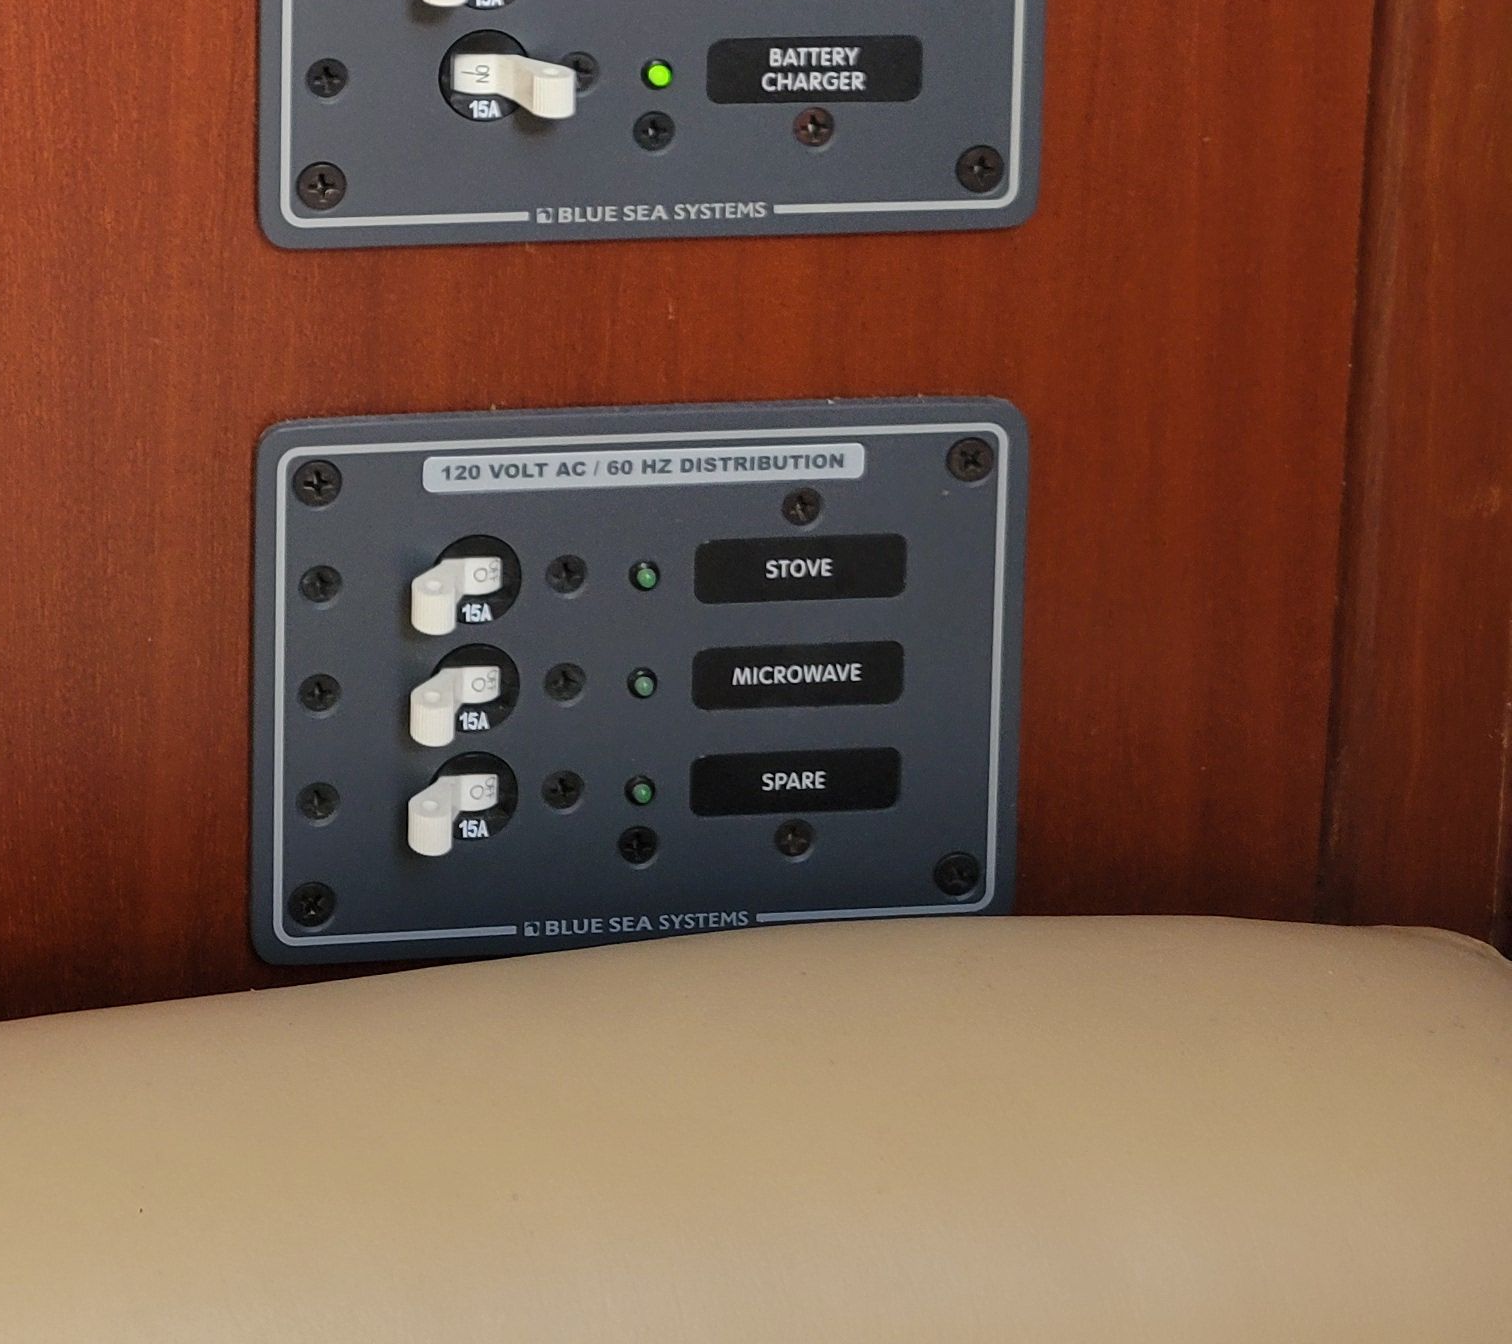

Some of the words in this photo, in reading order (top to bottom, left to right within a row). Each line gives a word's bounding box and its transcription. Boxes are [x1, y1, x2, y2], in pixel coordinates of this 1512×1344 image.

[770, 47, 858, 66] BATTERY
[476, 65, 489, 84] ON
[762, 72, 865, 91] CHARGER
[470, 100, 500, 118] 15A
[558, 206, 617, 223] BLUE
[624, 205, 668, 221] SEA
[674, 202, 767, 219] SYSTEMS
[442, 465, 480, 480] 120
[489, 463, 548, 479] VOLT
[556, 462, 585, 476] AC
[607, 460, 633, 475] 60
[642, 459, 672, 474] HZ
[680, 454, 844, 473] DISTRIBUTION
[766, 559, 832, 578] STOVE
[462, 604, 491, 622] 15A
[733, 664, 861, 685] MICROWAVE
[460, 712, 489, 730] 15A
[762, 771, 825, 790] SPARE
[459, 820, 488, 837] 15A
[546, 919, 603, 935] BLUE
[609, 916, 652, 932] SEA
[660, 911, 750, 930] SYSTEMS
